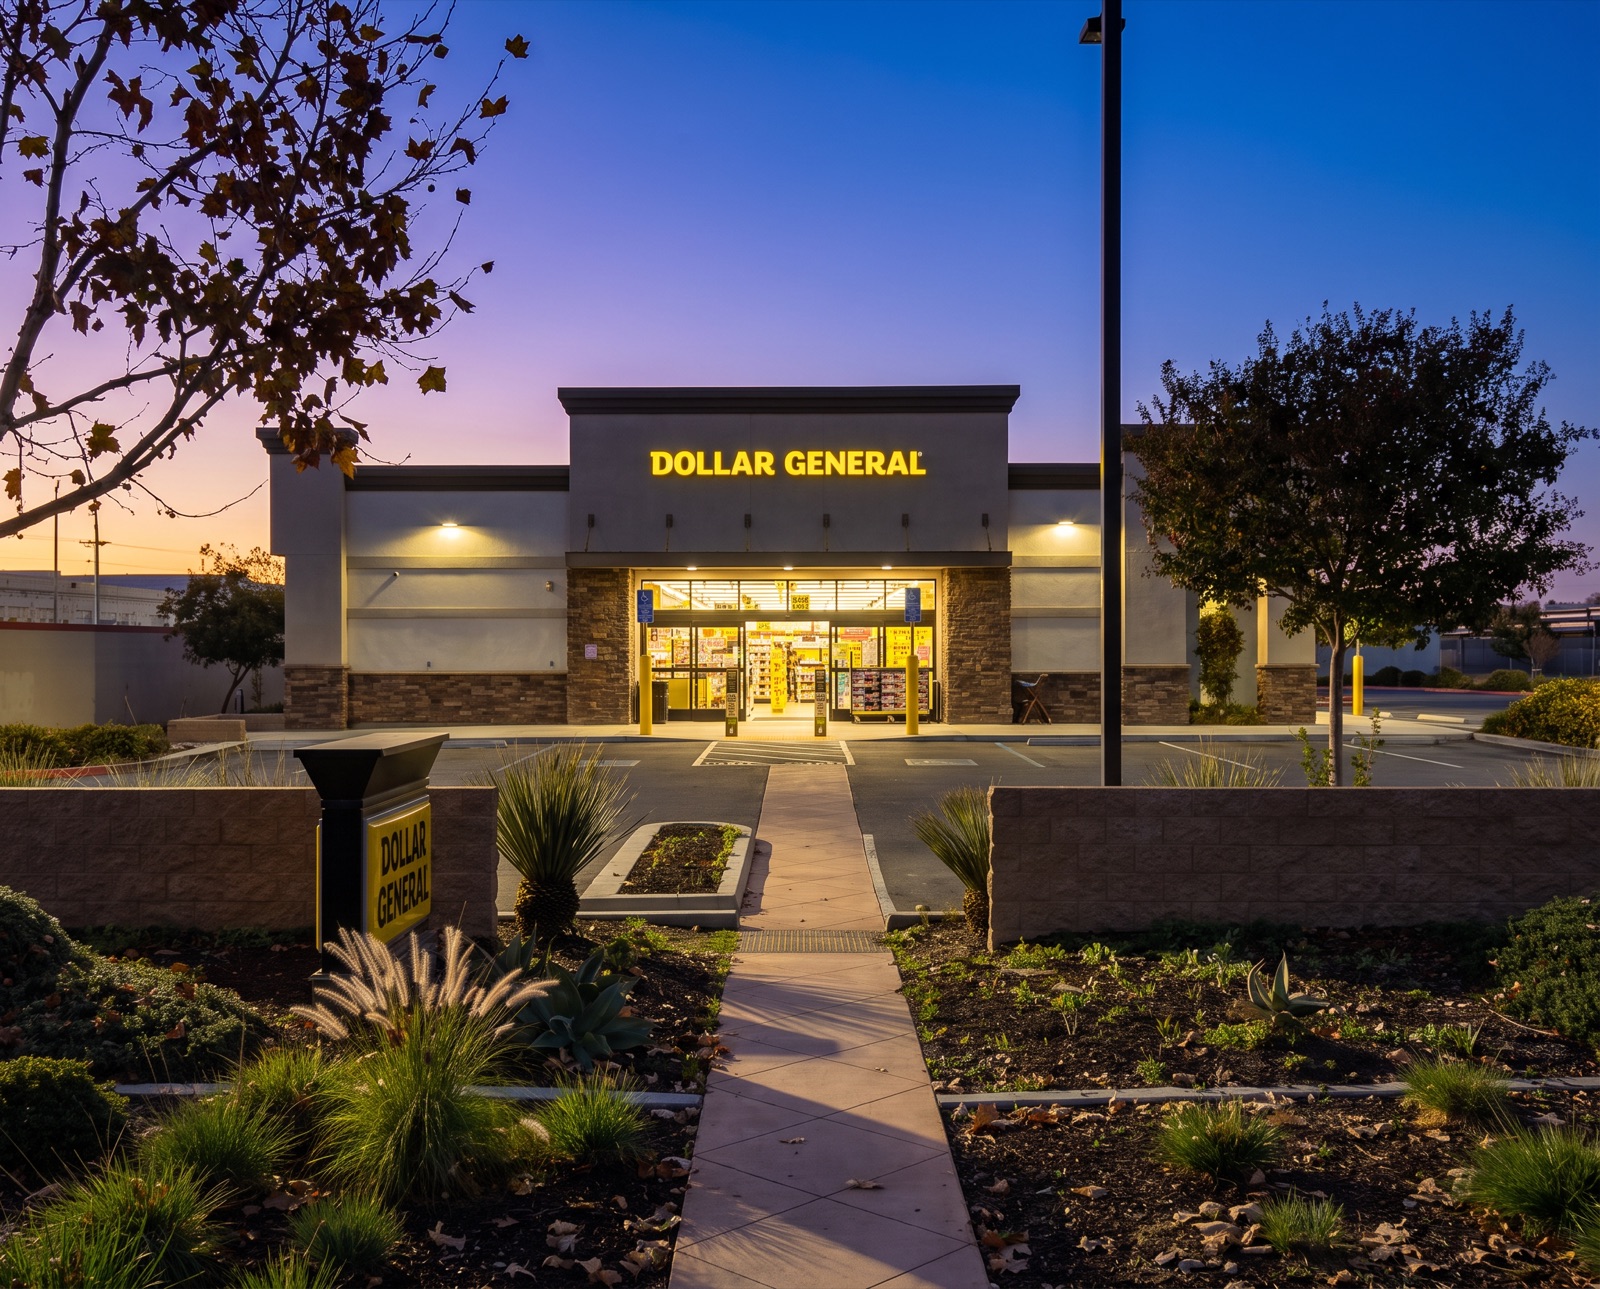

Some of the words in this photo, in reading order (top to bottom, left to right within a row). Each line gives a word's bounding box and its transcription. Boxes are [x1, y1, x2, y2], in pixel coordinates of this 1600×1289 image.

[650, 451, 776, 476] DOLLAR
[784, 451, 927, 476] GENERAL
[381, 820, 427, 877] DOLLAR
[377, 864, 429, 929] GENERAL
